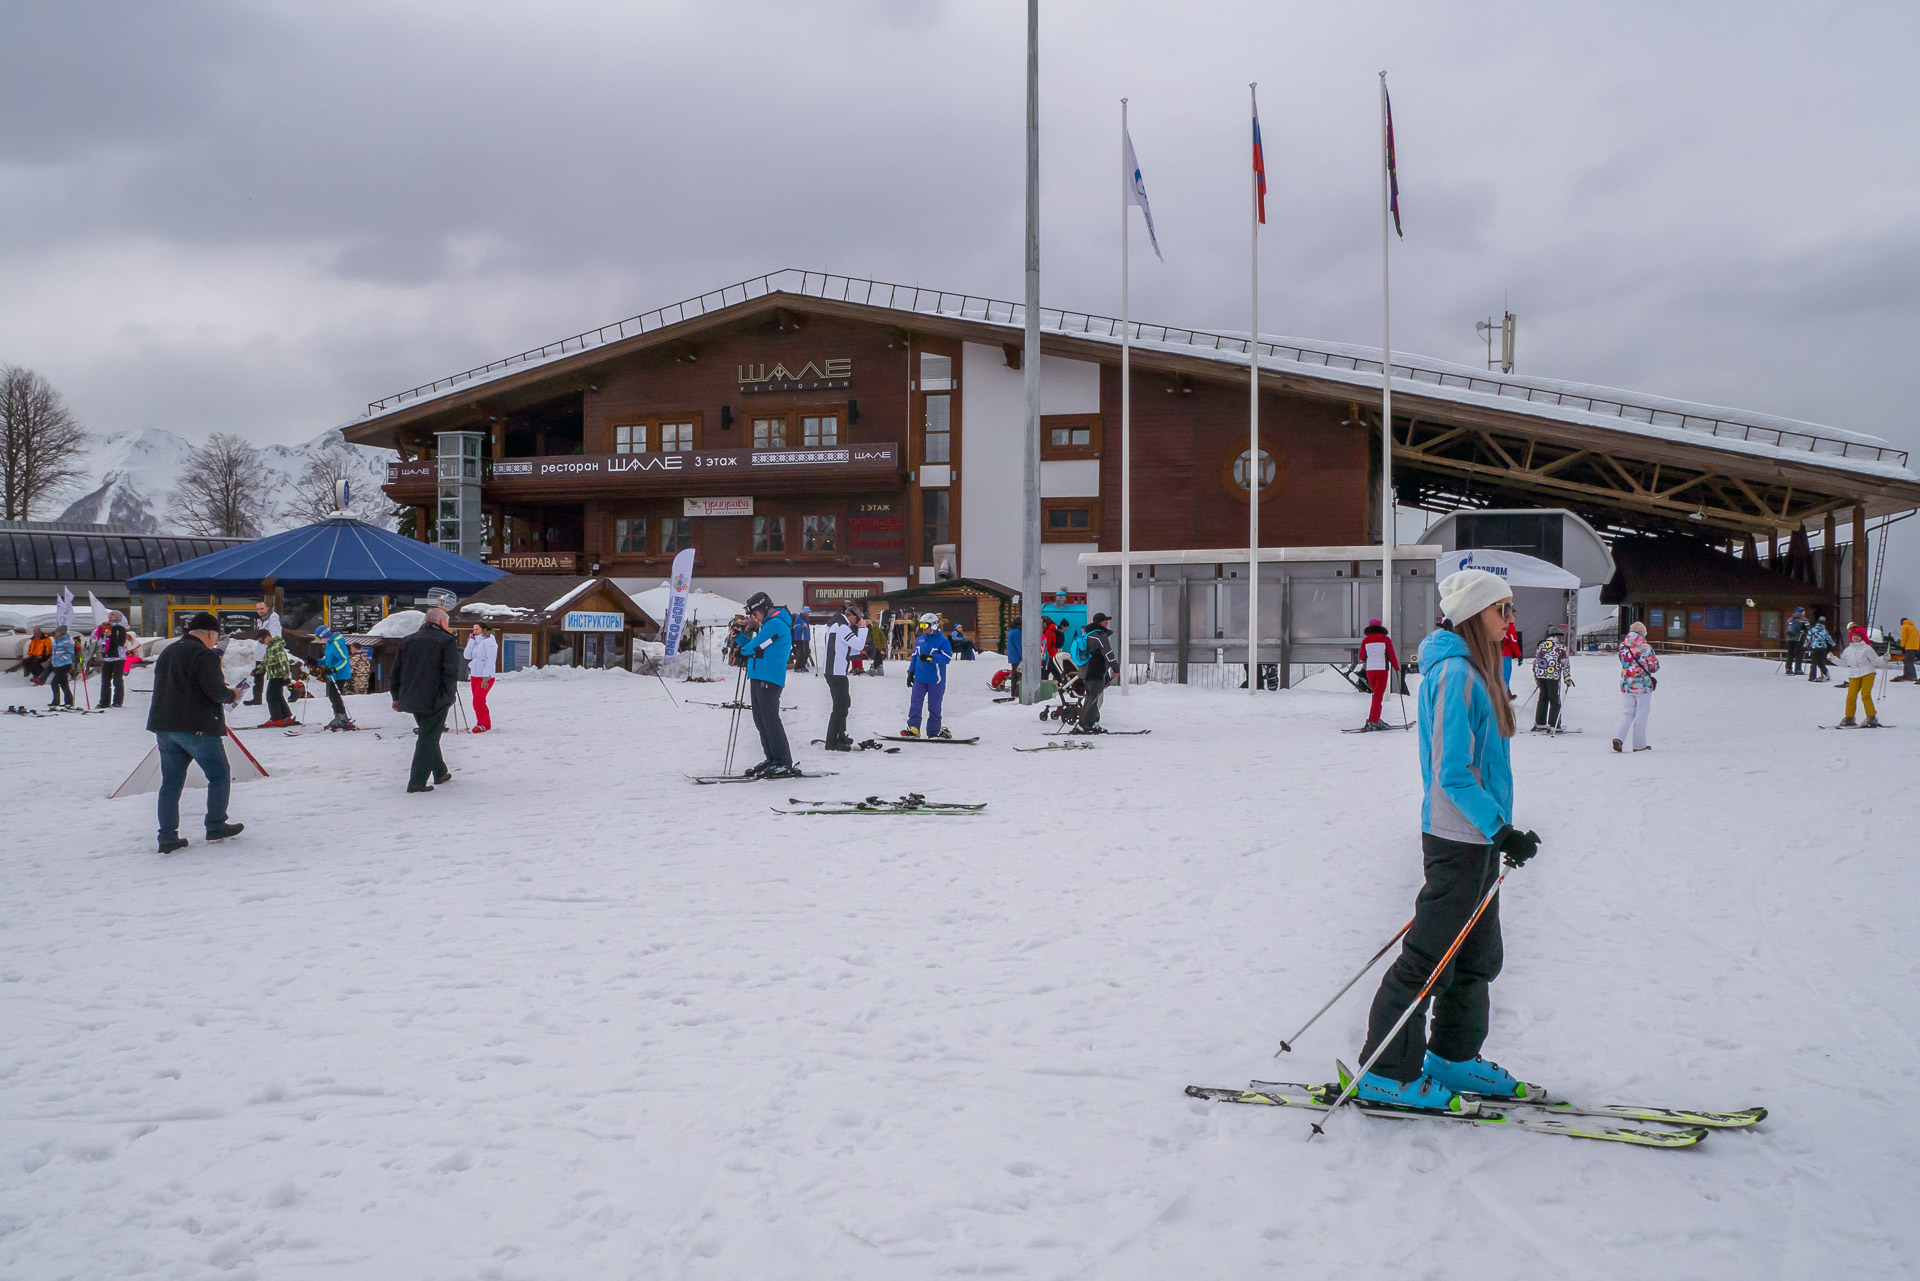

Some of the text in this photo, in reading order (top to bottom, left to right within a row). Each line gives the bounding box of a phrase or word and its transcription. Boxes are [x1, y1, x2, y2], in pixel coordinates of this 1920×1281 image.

[740, 381, 848, 392] РЕСТОРАН
[541, 462, 599, 474] ресторан
[694, 456, 702, 467] 3
[706, 456, 738, 467] этаж
[860, 504, 865, 512] 2
[500, 557, 558, 568] ПРИПРАВА
[815, 588, 869, 599] ГОРНЫЙ ПРИЮТ
[567, 614, 622, 629] ИНСТРУКТОРЫ
[1468, 1072, 1497, 1085] LANGE
